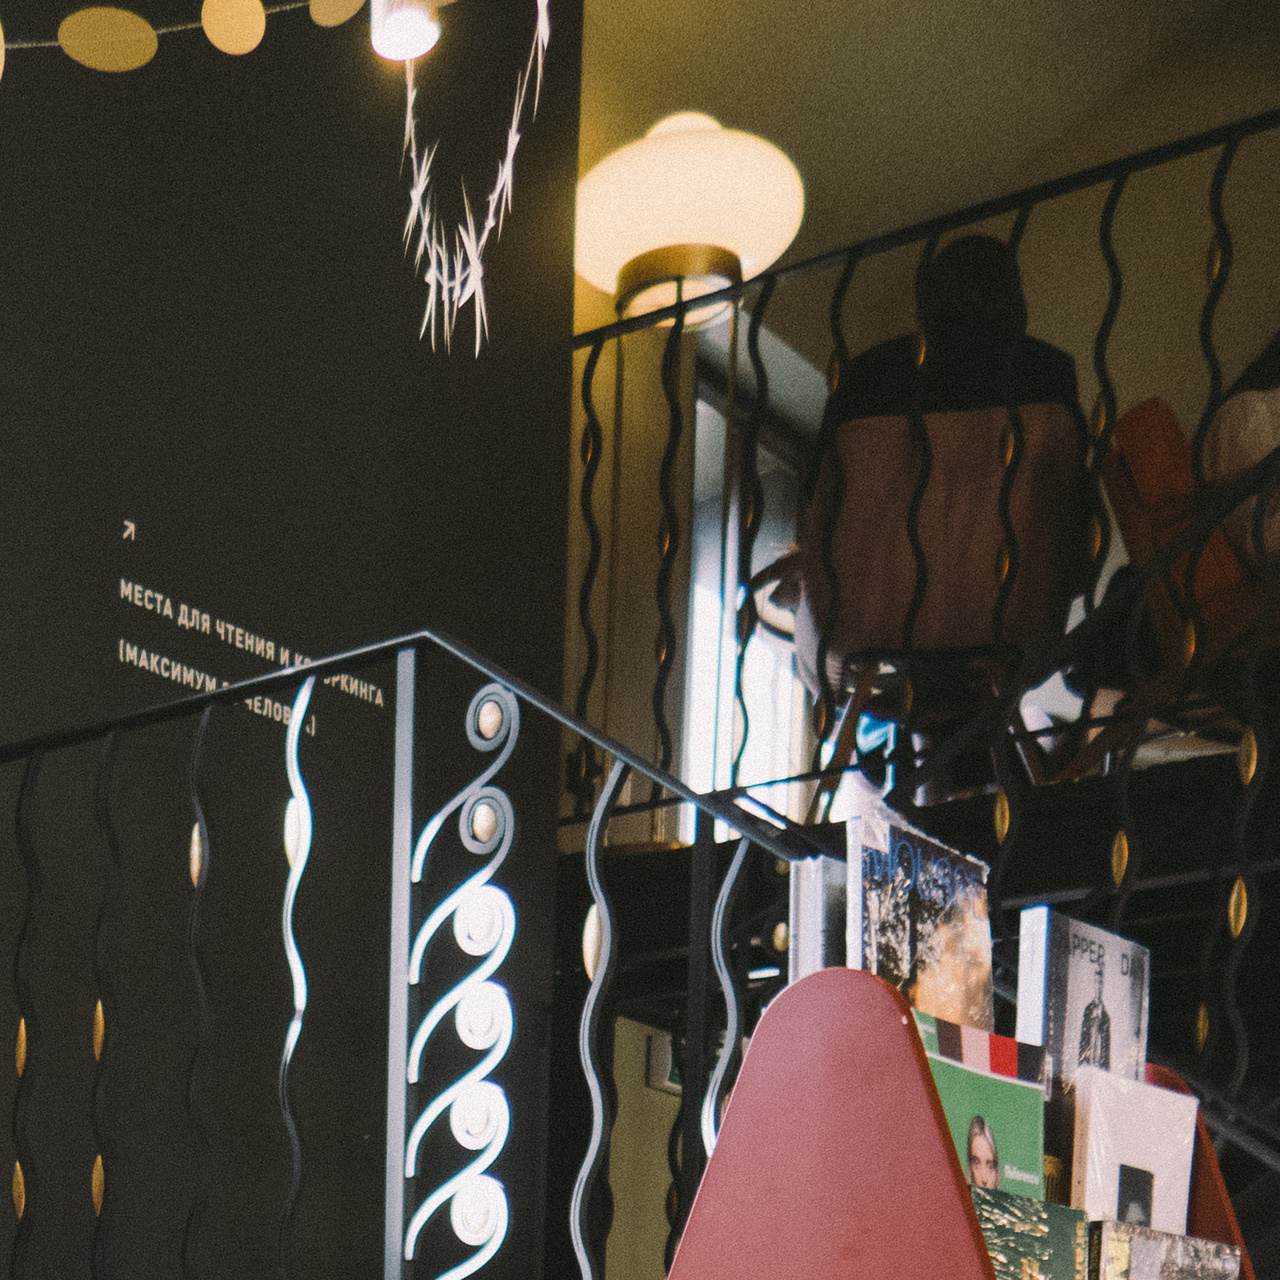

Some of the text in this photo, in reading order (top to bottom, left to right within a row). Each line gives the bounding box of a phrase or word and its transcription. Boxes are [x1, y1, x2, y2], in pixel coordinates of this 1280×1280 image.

[120, 577, 384, 707] МЕСТА ДЛЯ ЧТЕНИЯ И КОРКИНГА
